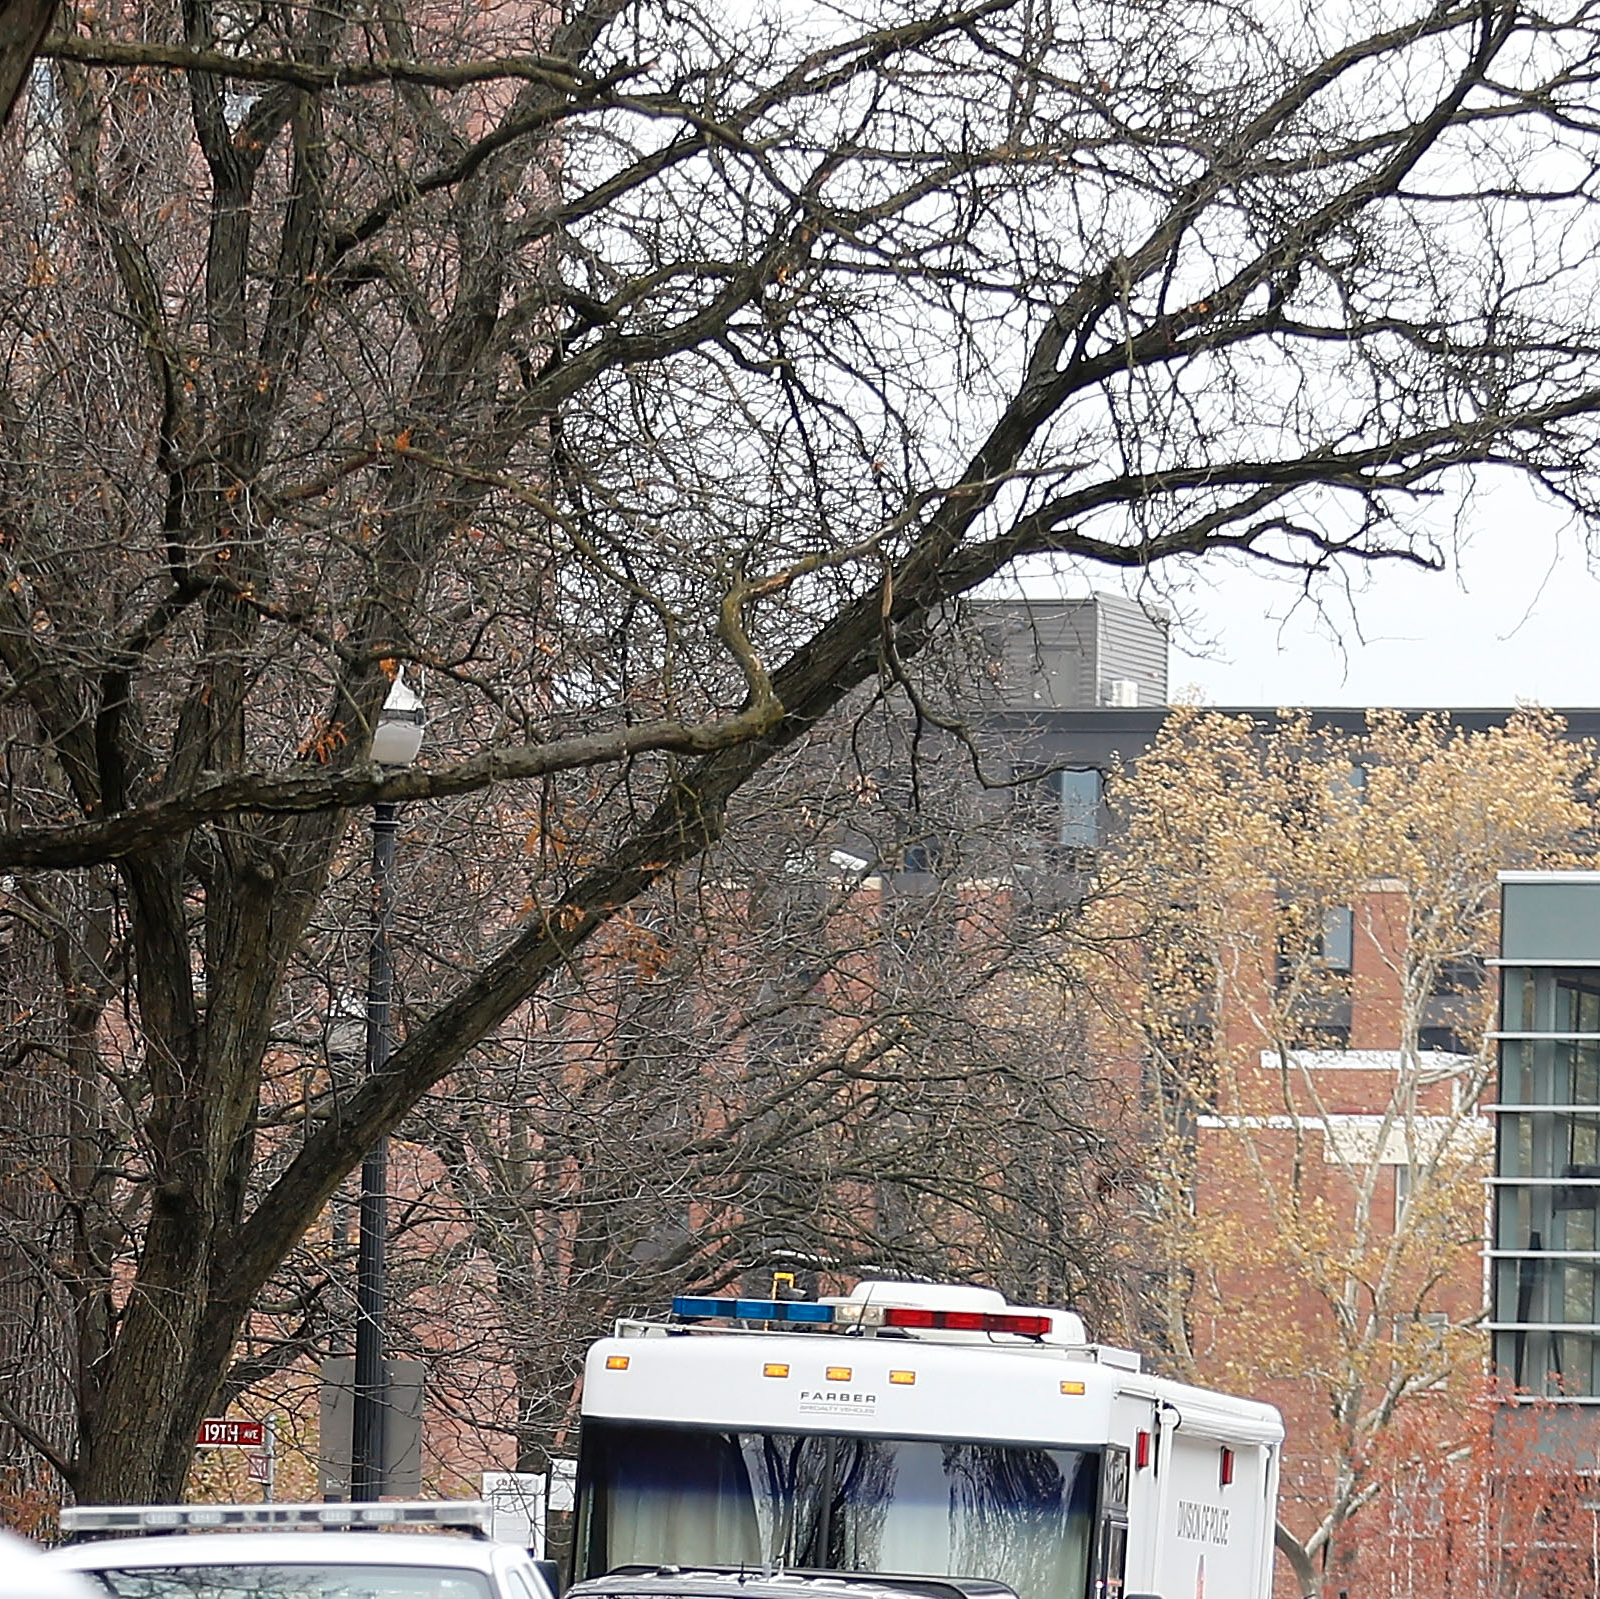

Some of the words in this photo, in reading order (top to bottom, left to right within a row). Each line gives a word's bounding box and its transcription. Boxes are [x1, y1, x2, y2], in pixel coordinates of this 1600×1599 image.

[800, 1392, 875, 1402] FARBER
[204, 1424, 238, 1442] 19TH
[243, 1429, 258, 1440] AVE
